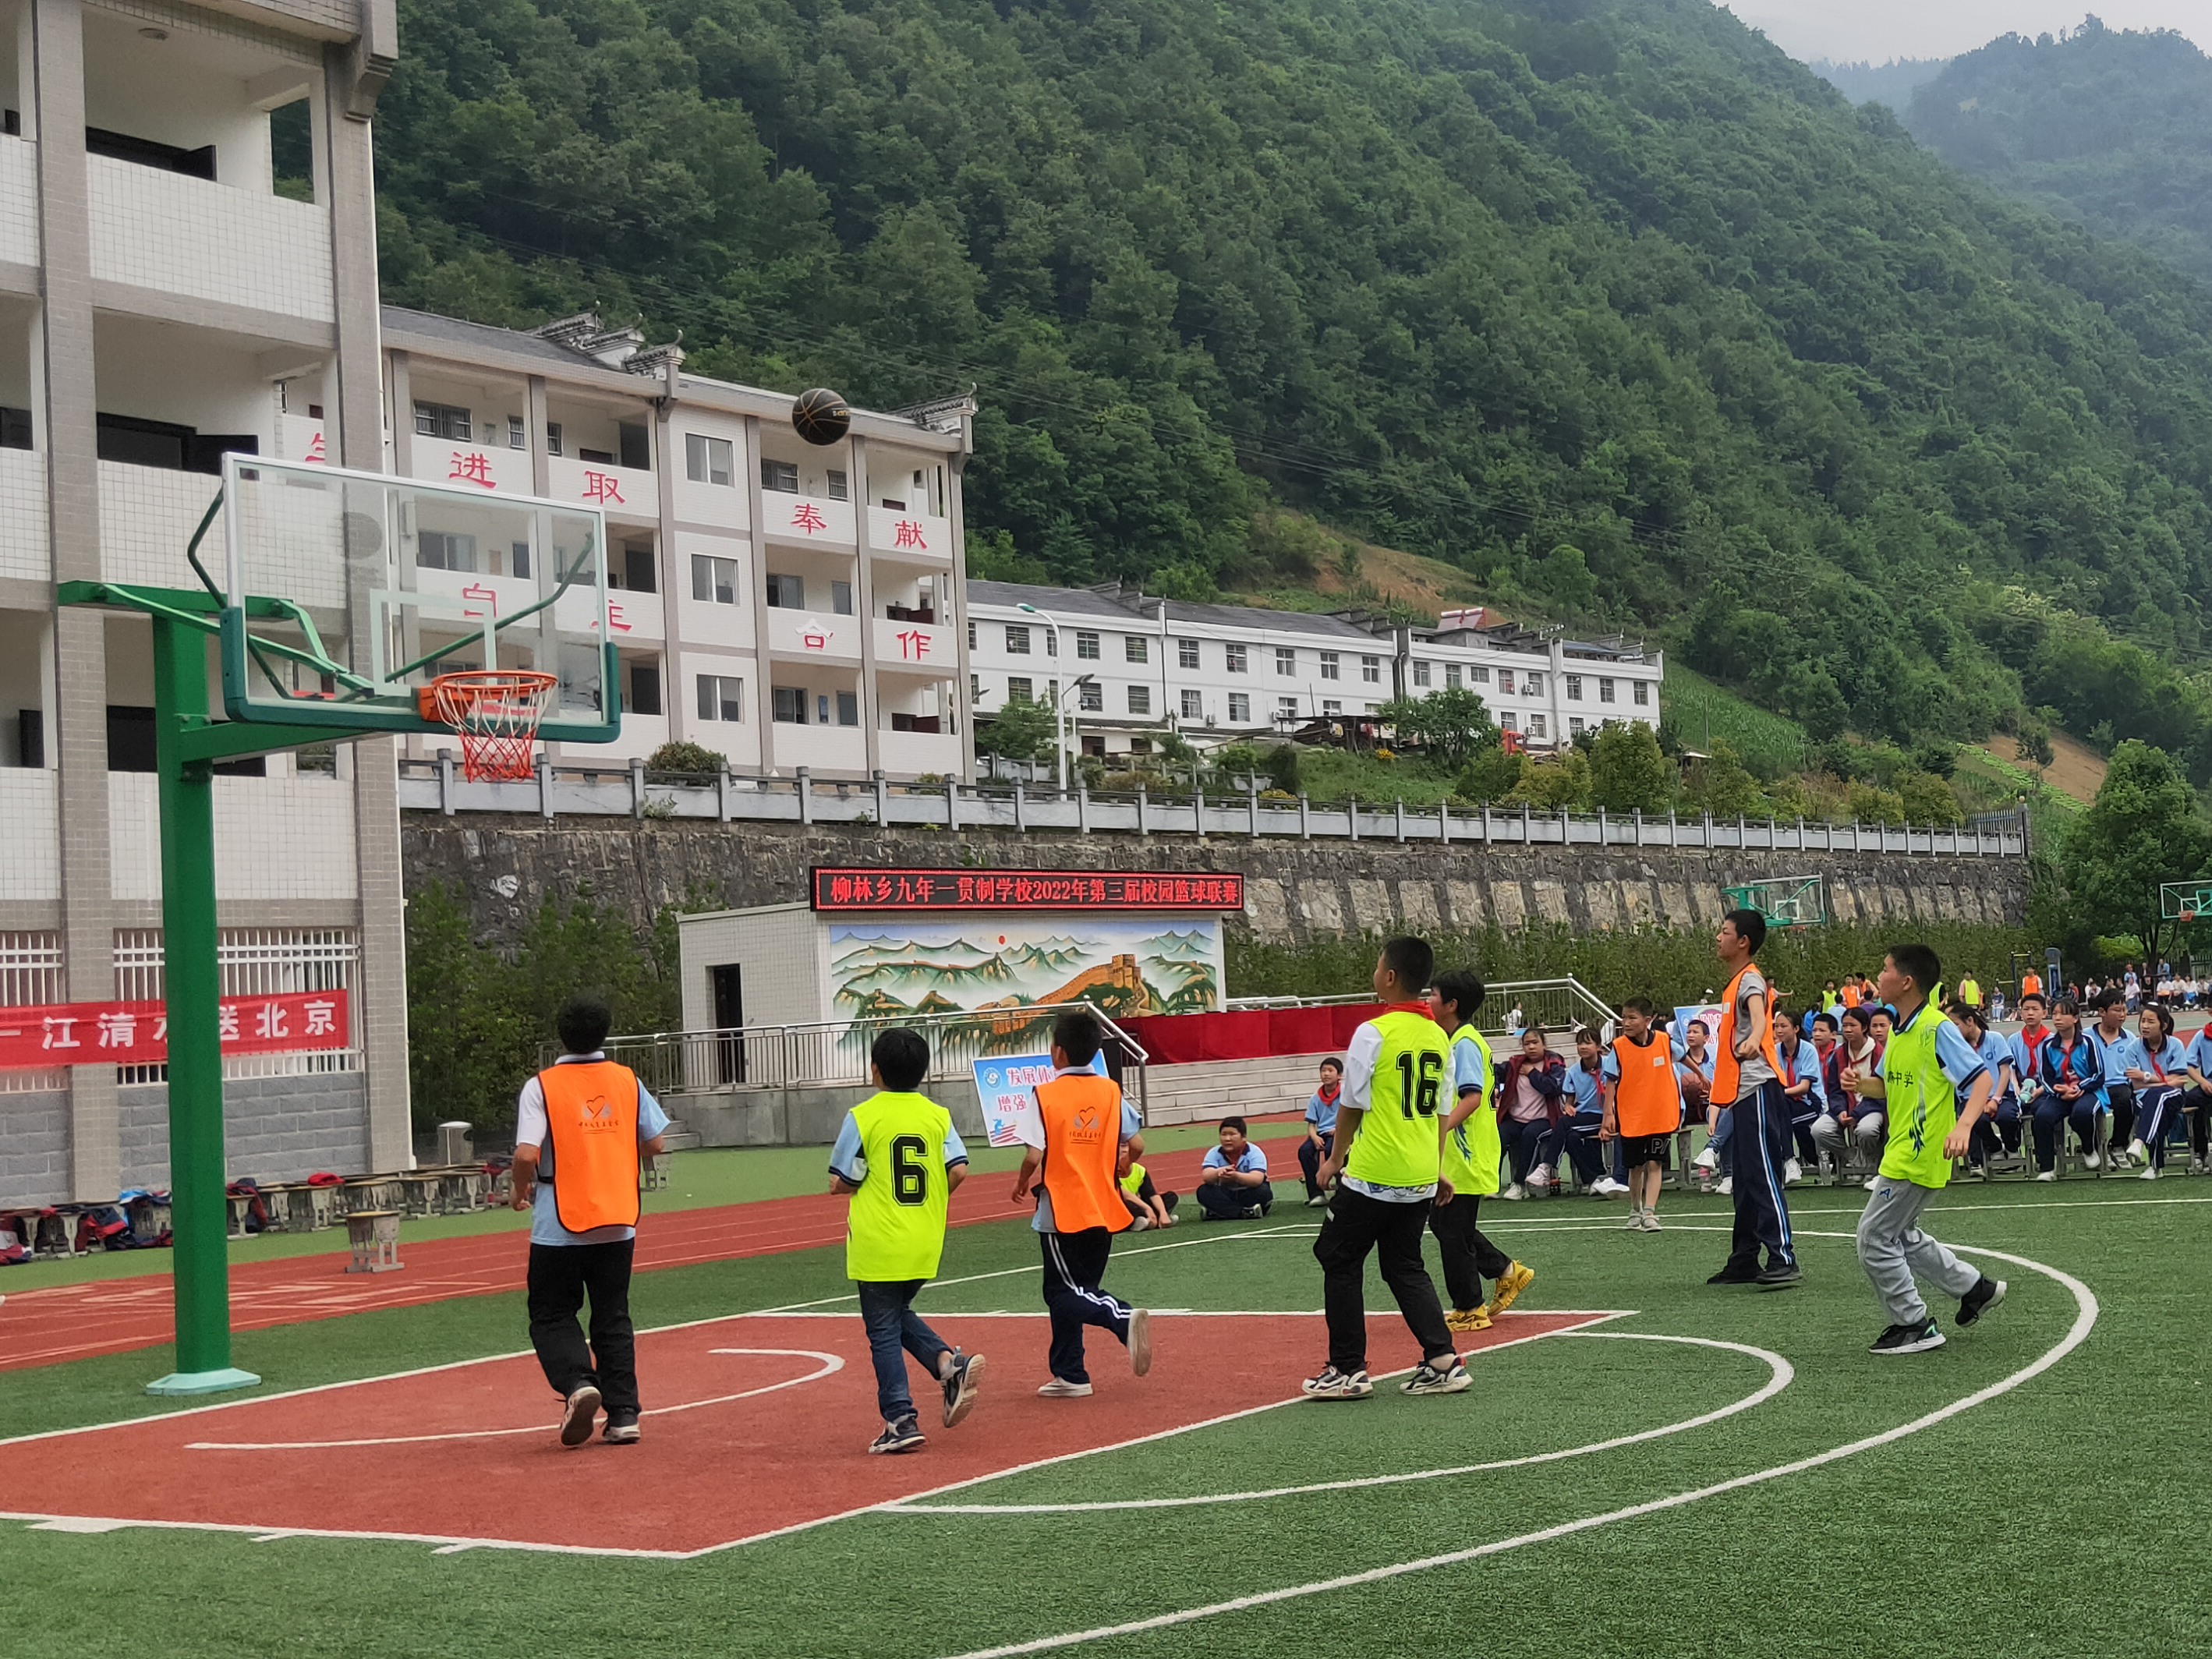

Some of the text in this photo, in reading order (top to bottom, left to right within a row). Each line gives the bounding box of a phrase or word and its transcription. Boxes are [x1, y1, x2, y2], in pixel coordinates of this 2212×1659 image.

[830, 875, 1238, 904] 柳林乡九年一贯制学校2022年第三届校园篮球联赛
[996, 1094, 1028, 1113] 增强
[1396, 1049, 1443, 1121] 16
[890, 1134, 929, 1207] 6
